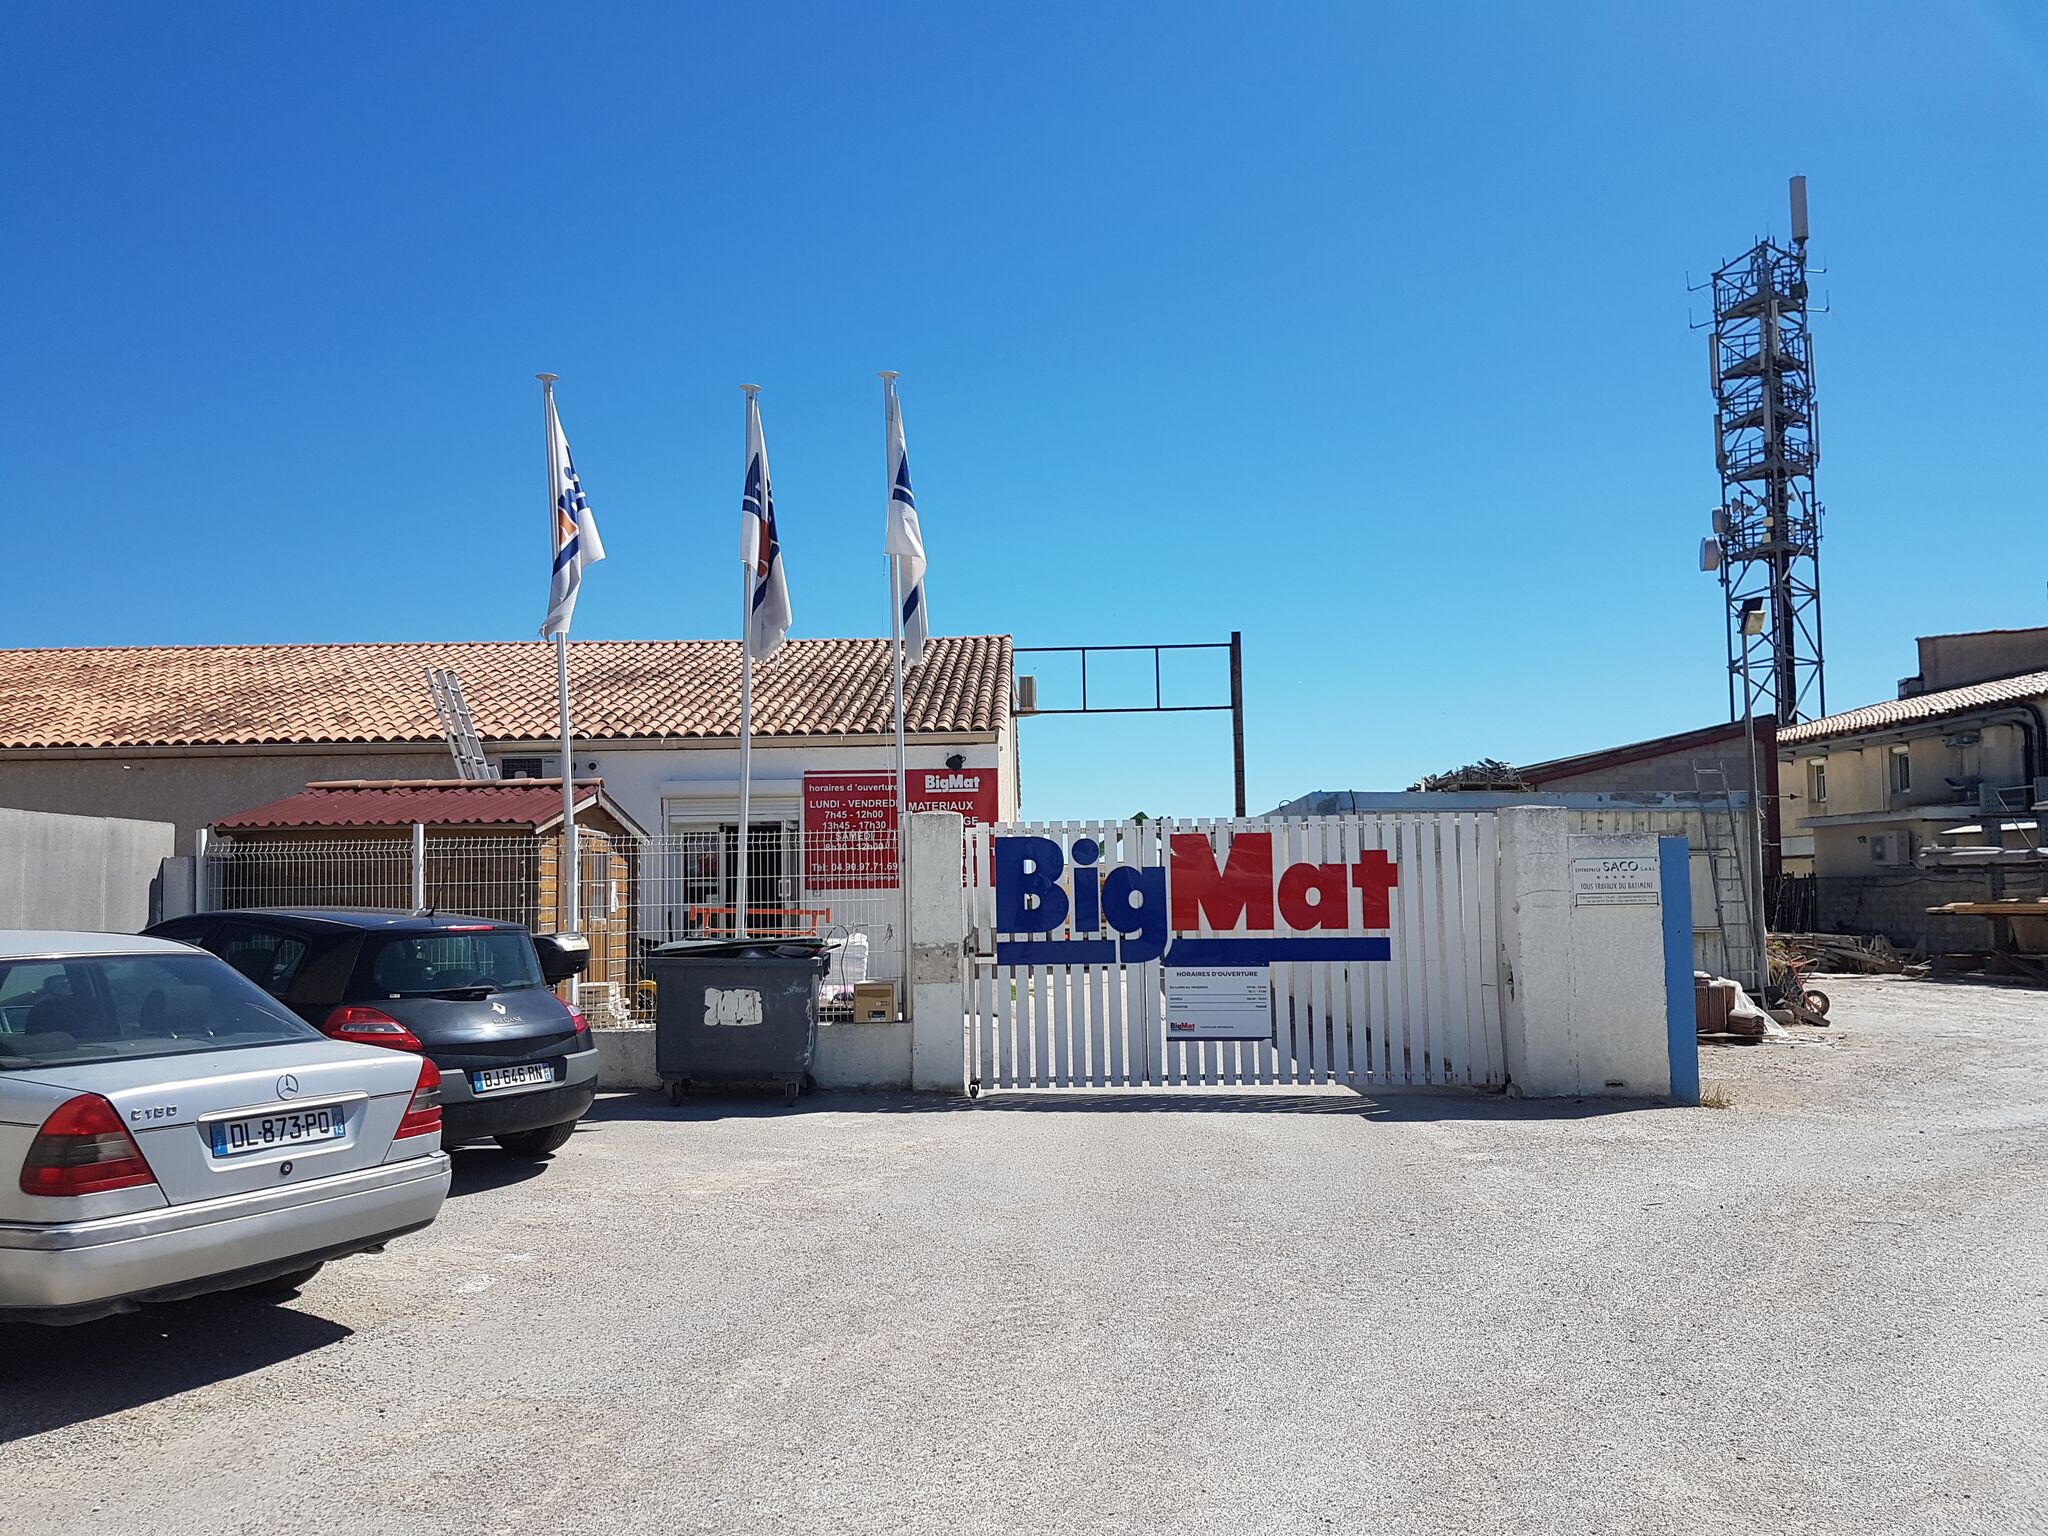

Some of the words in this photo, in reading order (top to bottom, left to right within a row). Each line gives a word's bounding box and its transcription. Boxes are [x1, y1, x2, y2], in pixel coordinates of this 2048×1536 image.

[925, 774, 980, 792] BigMat
[809, 784, 845, 792] horaires
[908, 801, 974, 811] MATERIAUX
[825, 811, 847, 819] 7h45
[856, 810, 883, 818] 12h00
[823, 822, 850, 830] 13h45
[859, 821, 886, 829] 17h30
[836, 832, 875, 840] SAMEDI
[1602, 861, 1639, 872] SACO
[1595, 882, 1617, 890] TRAVAUX
[995, 833, 1398, 963] BigMat
[1170, 1022, 1195, 1031] BigMat
